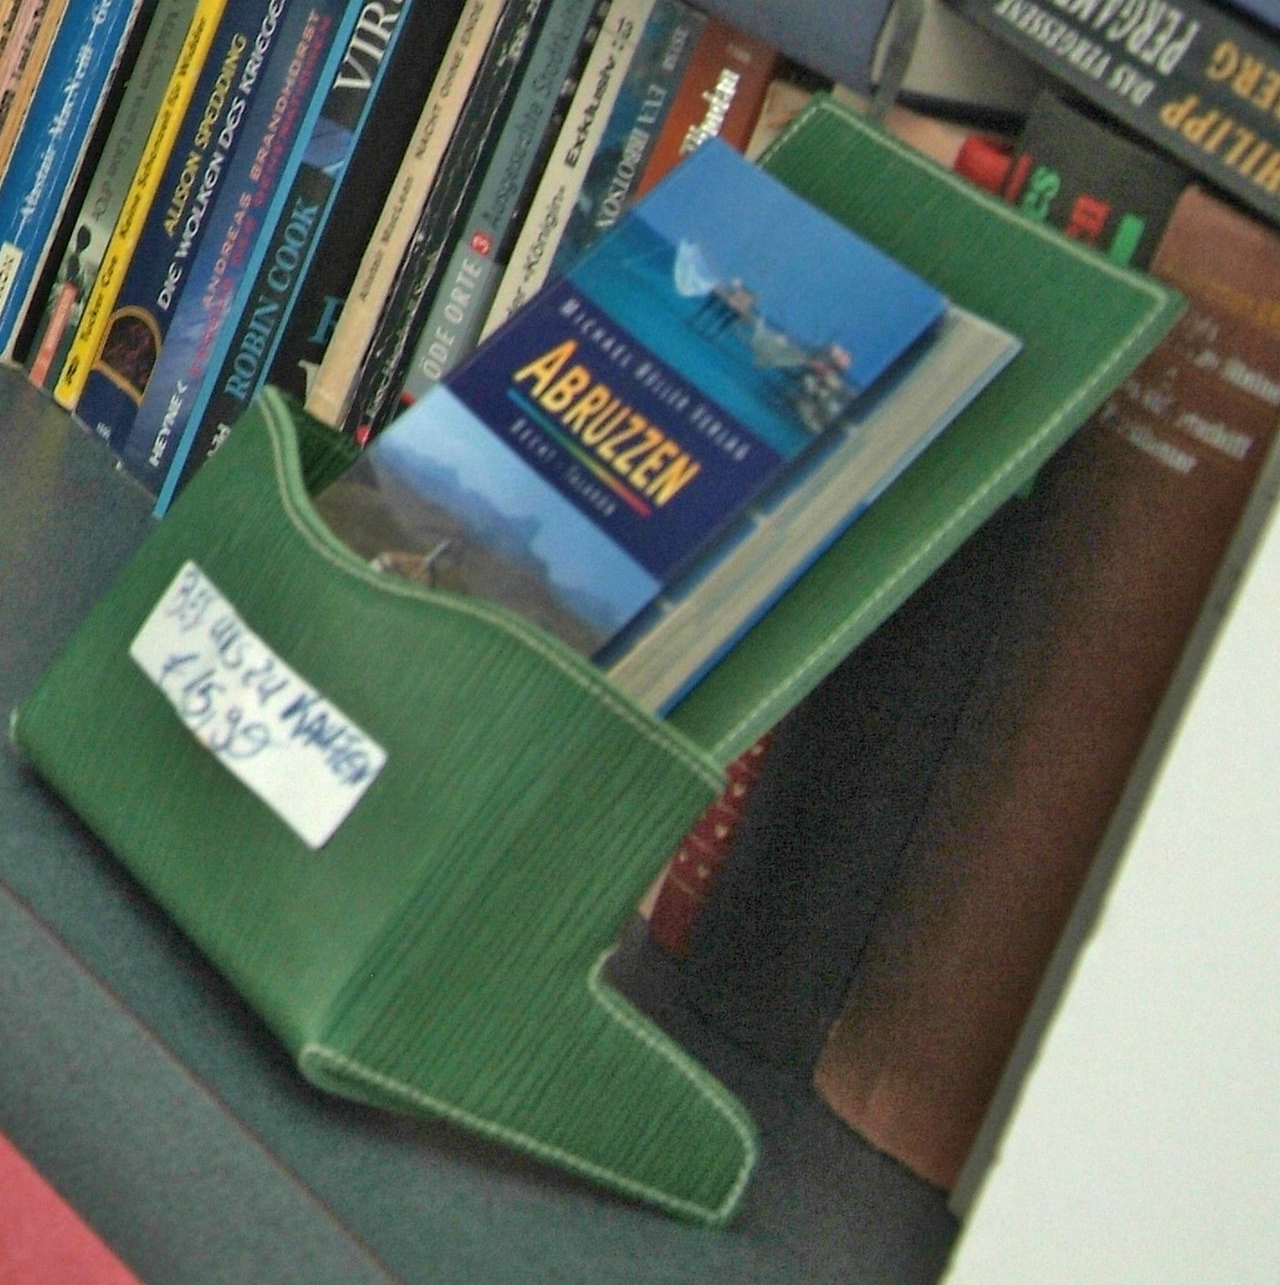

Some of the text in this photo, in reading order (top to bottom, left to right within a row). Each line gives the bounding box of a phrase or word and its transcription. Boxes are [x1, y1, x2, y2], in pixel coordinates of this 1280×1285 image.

[162, 32, 247, 236] ALISON SPEDDING
[380, 174, 415, 244] MacLean
[412, 103, 445, 160] NACHT
[436, 49, 466, 99] OHNE
[458, 0, 486, 46] ENDE
[562, 55, 618, 167] Exklusiv
[1103, 61, 1155, 105] DAS
[147, 9, 324, 466] HEYNE ANDREAS BRANDHORST
[155, 261, 184, 310] DIE
[175, 150, 225, 259] WOLKEN
[217, 95, 246, 149] DES
[223, 296, 280, 400] ROBIN
[265, 197, 318, 292] COOK
[418, 326, 456, 378] ÖDE
[440, 258, 484, 323] ORTE
[481, 98, 549, 227] Ausgesuchte
[512, 338, 702, 508] ABRUZZEN
[559, 298, 633, 368] MICHAEL
